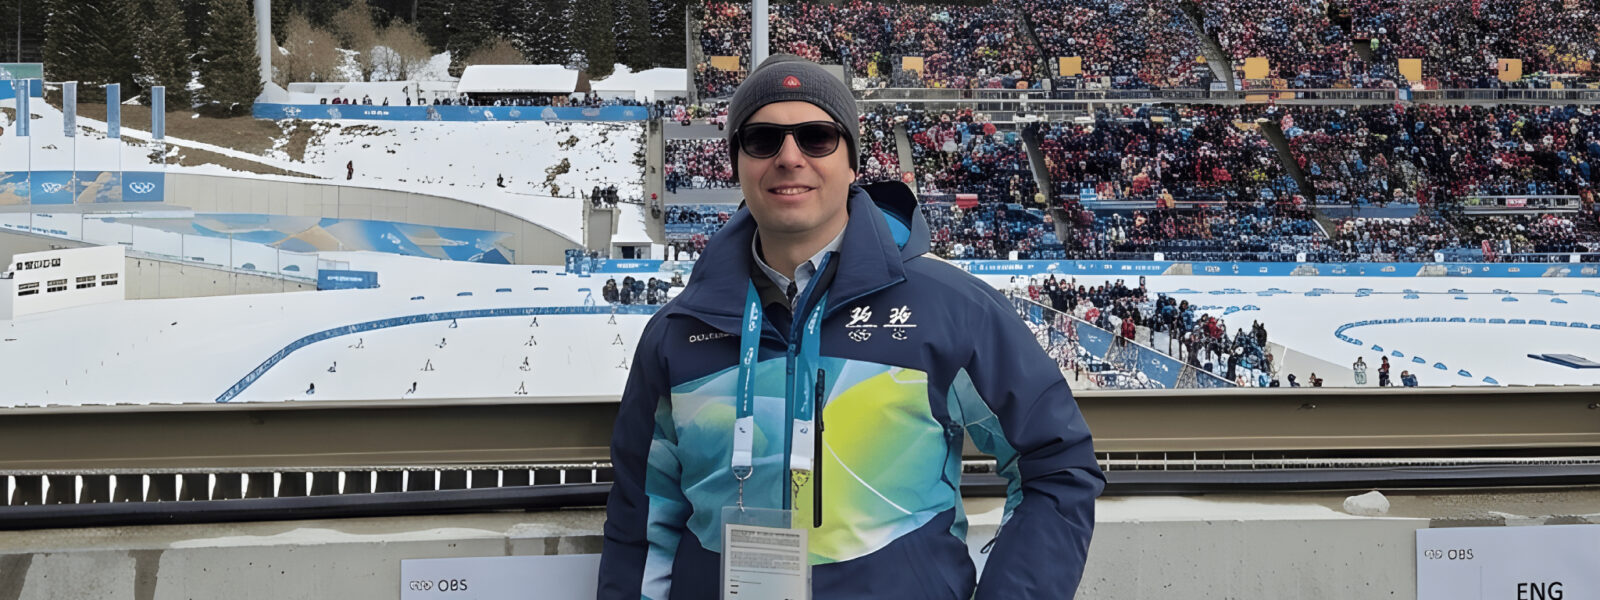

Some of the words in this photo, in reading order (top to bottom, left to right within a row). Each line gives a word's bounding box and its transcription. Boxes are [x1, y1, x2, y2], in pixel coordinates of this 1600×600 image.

[1447, 548, 1474, 560] OBS
[438, 579, 468, 592] OBS
[1517, 581, 1564, 600] ENG
